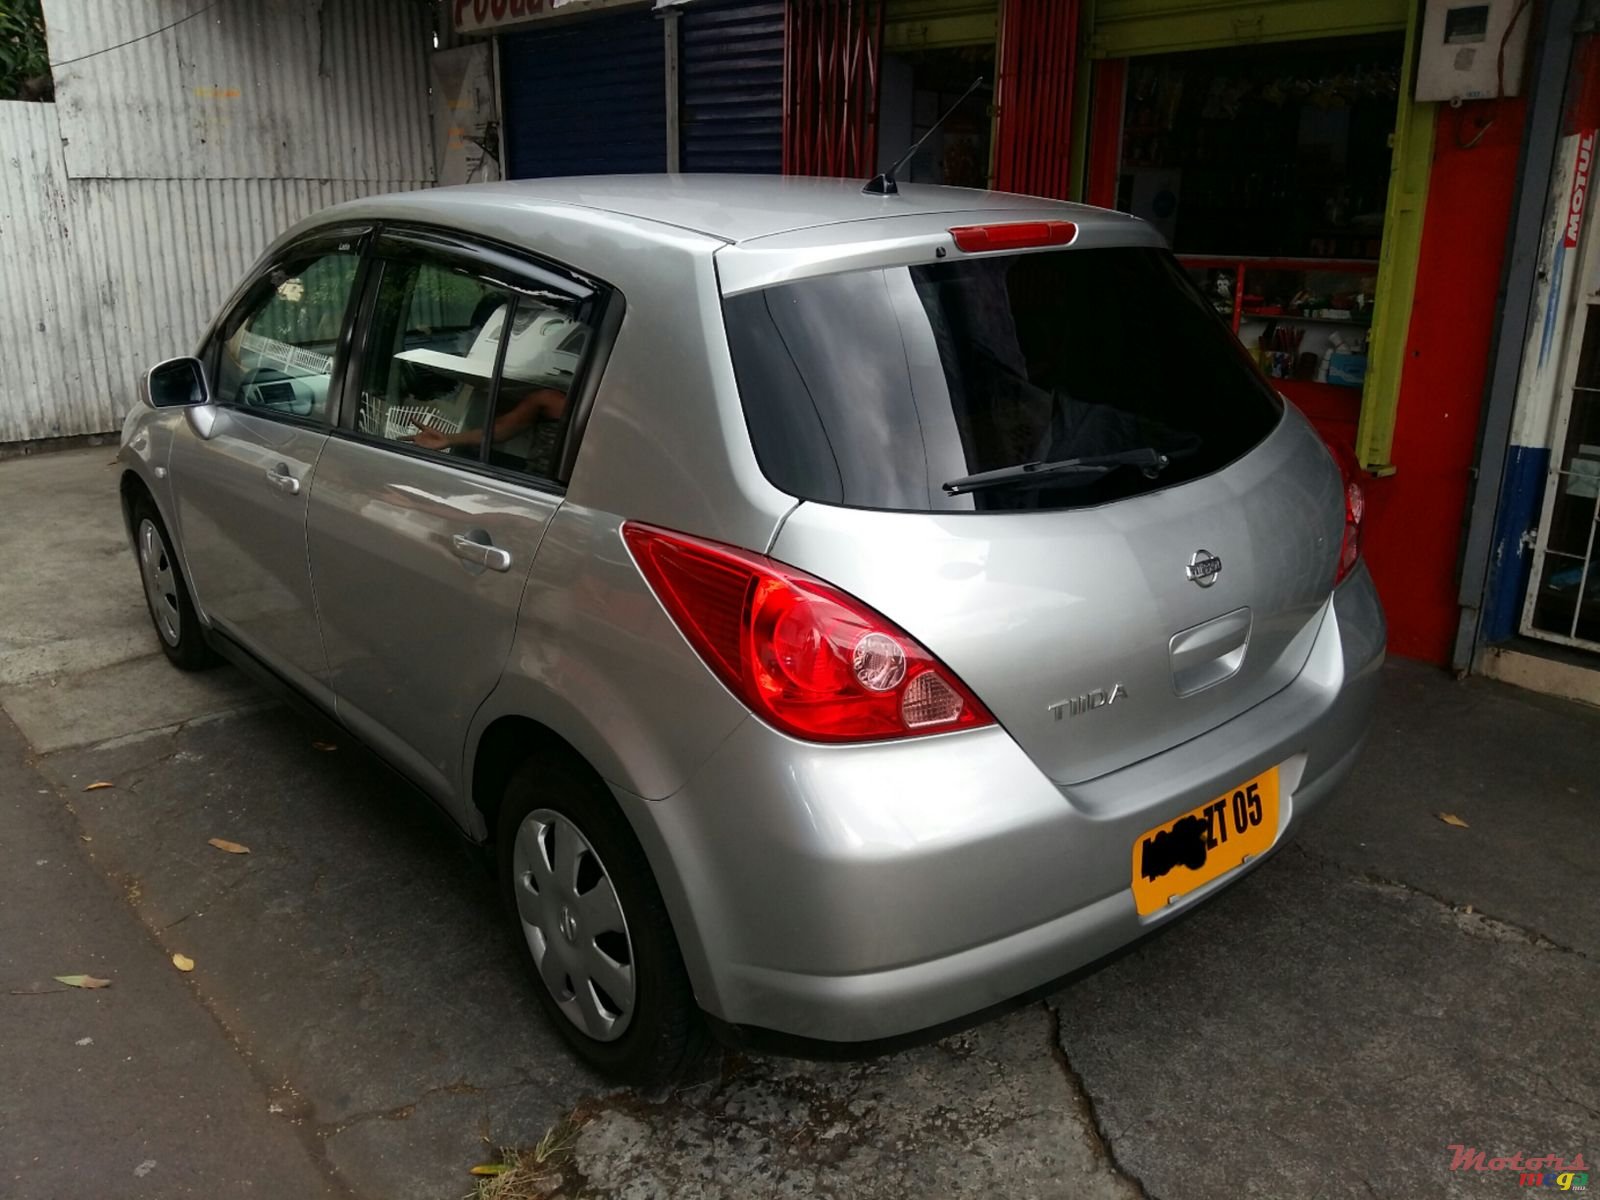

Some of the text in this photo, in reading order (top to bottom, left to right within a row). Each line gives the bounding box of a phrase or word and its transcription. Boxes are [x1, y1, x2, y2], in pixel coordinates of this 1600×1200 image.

[1568, 134, 1593, 241] MOTUL
[1048, 683, 1128, 720] TIIDA
[1203, 799, 1227, 851] ZT
[1232, 782, 1262, 834] 05
